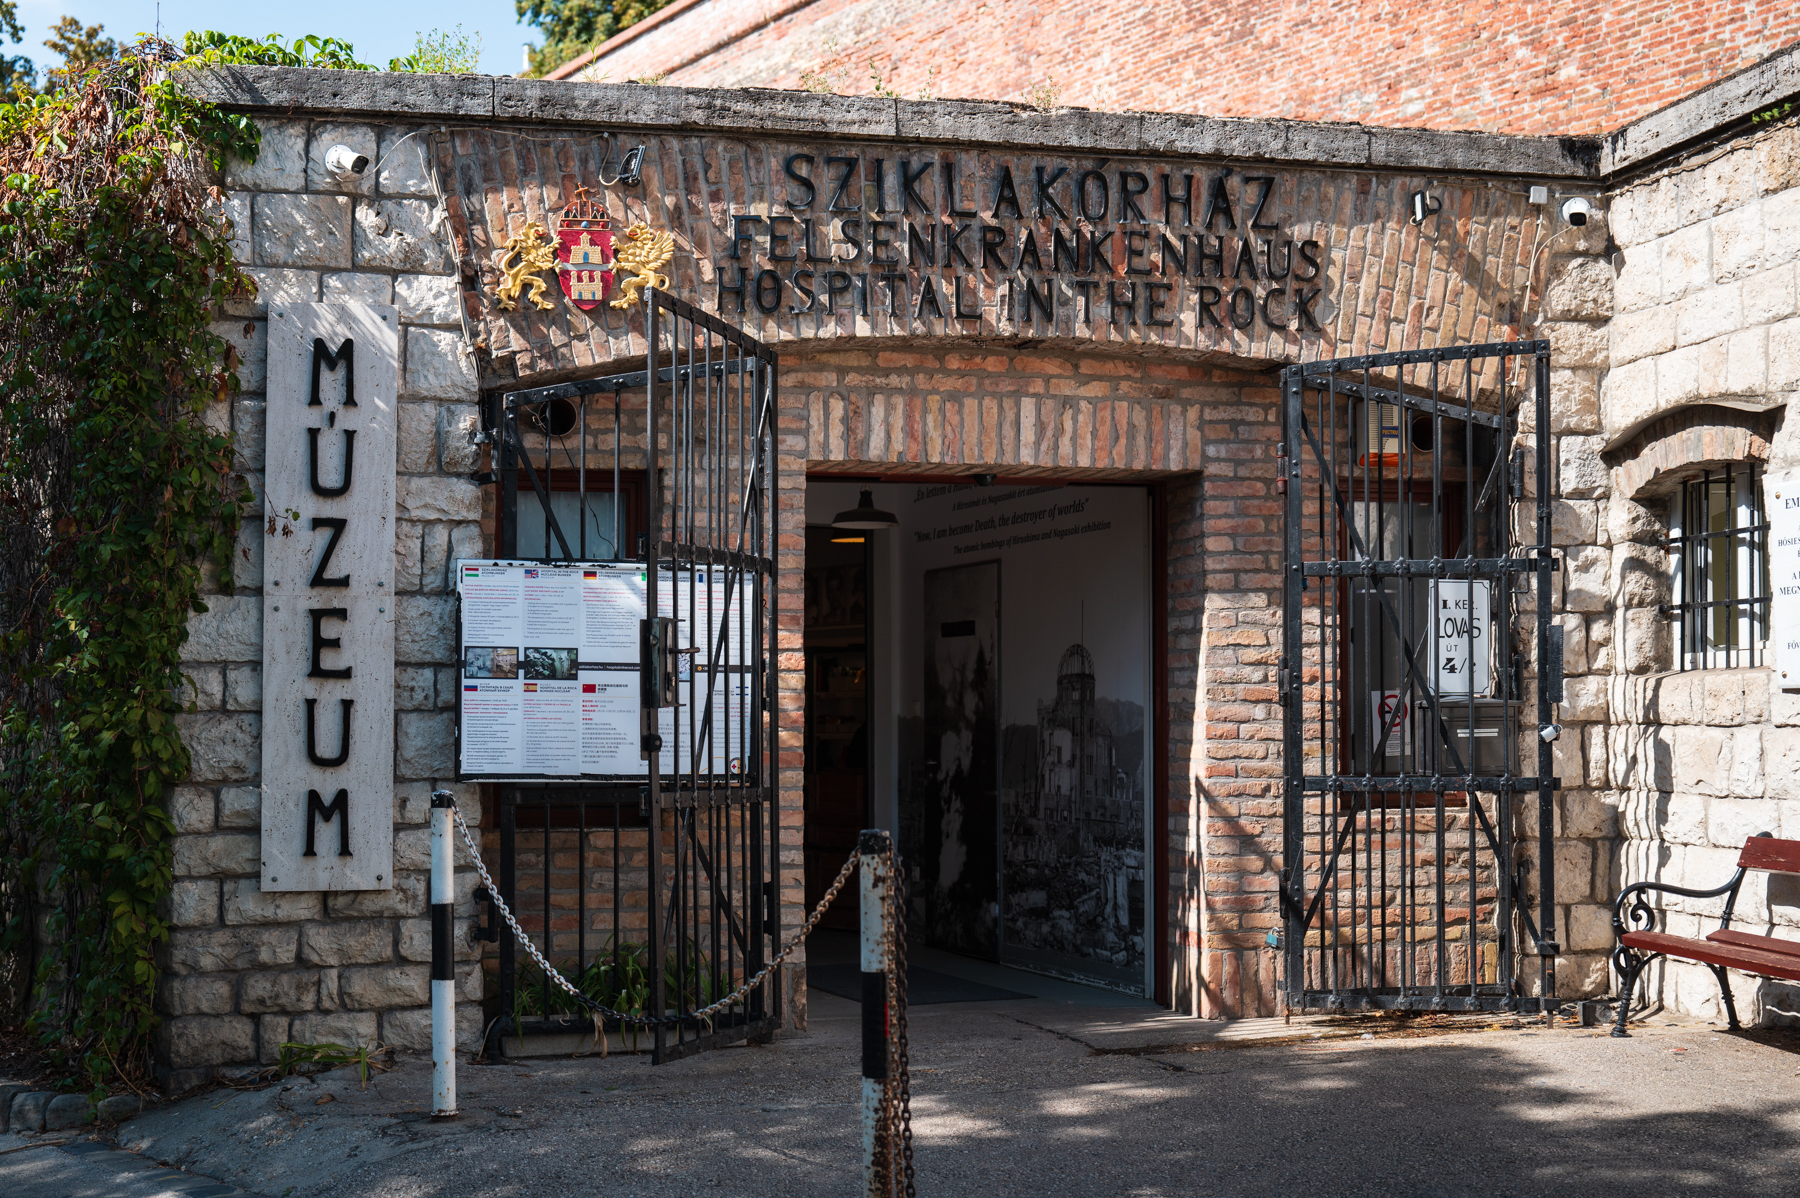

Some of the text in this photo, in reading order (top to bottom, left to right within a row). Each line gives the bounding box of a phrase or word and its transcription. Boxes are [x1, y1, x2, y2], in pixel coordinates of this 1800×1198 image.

[786, 153, 1279, 231] SZIKLAKÓRHÁZ
[731, 215, 1320, 282] FELSENKRANKENHAUS
[716, 266, 1323, 332] HOSPITAL IN THE ROCK
[952, 503, 956, 512] A
[981, 495, 988, 506] és
[1017, 487, 1026, 498] ért
[932, 528, 937, 539] I
[937, 528, 947, 539] am
[948, 523, 973, 537] become
[974, 516, 997, 532] Death,
[998, 514, 1010, 527] the
[1011, 509, 1047, 524] destroyer
[1047, 504, 1058, 521] of
[953, 520, 1112, 555] The atomic bombings of Hiroshima and Nagasaki exhibition
[303, 337, 358, 857] MÚZEUM
[1455, 599, 1478, 610] KE.
[1446, 643, 1459, 652] ÚT
